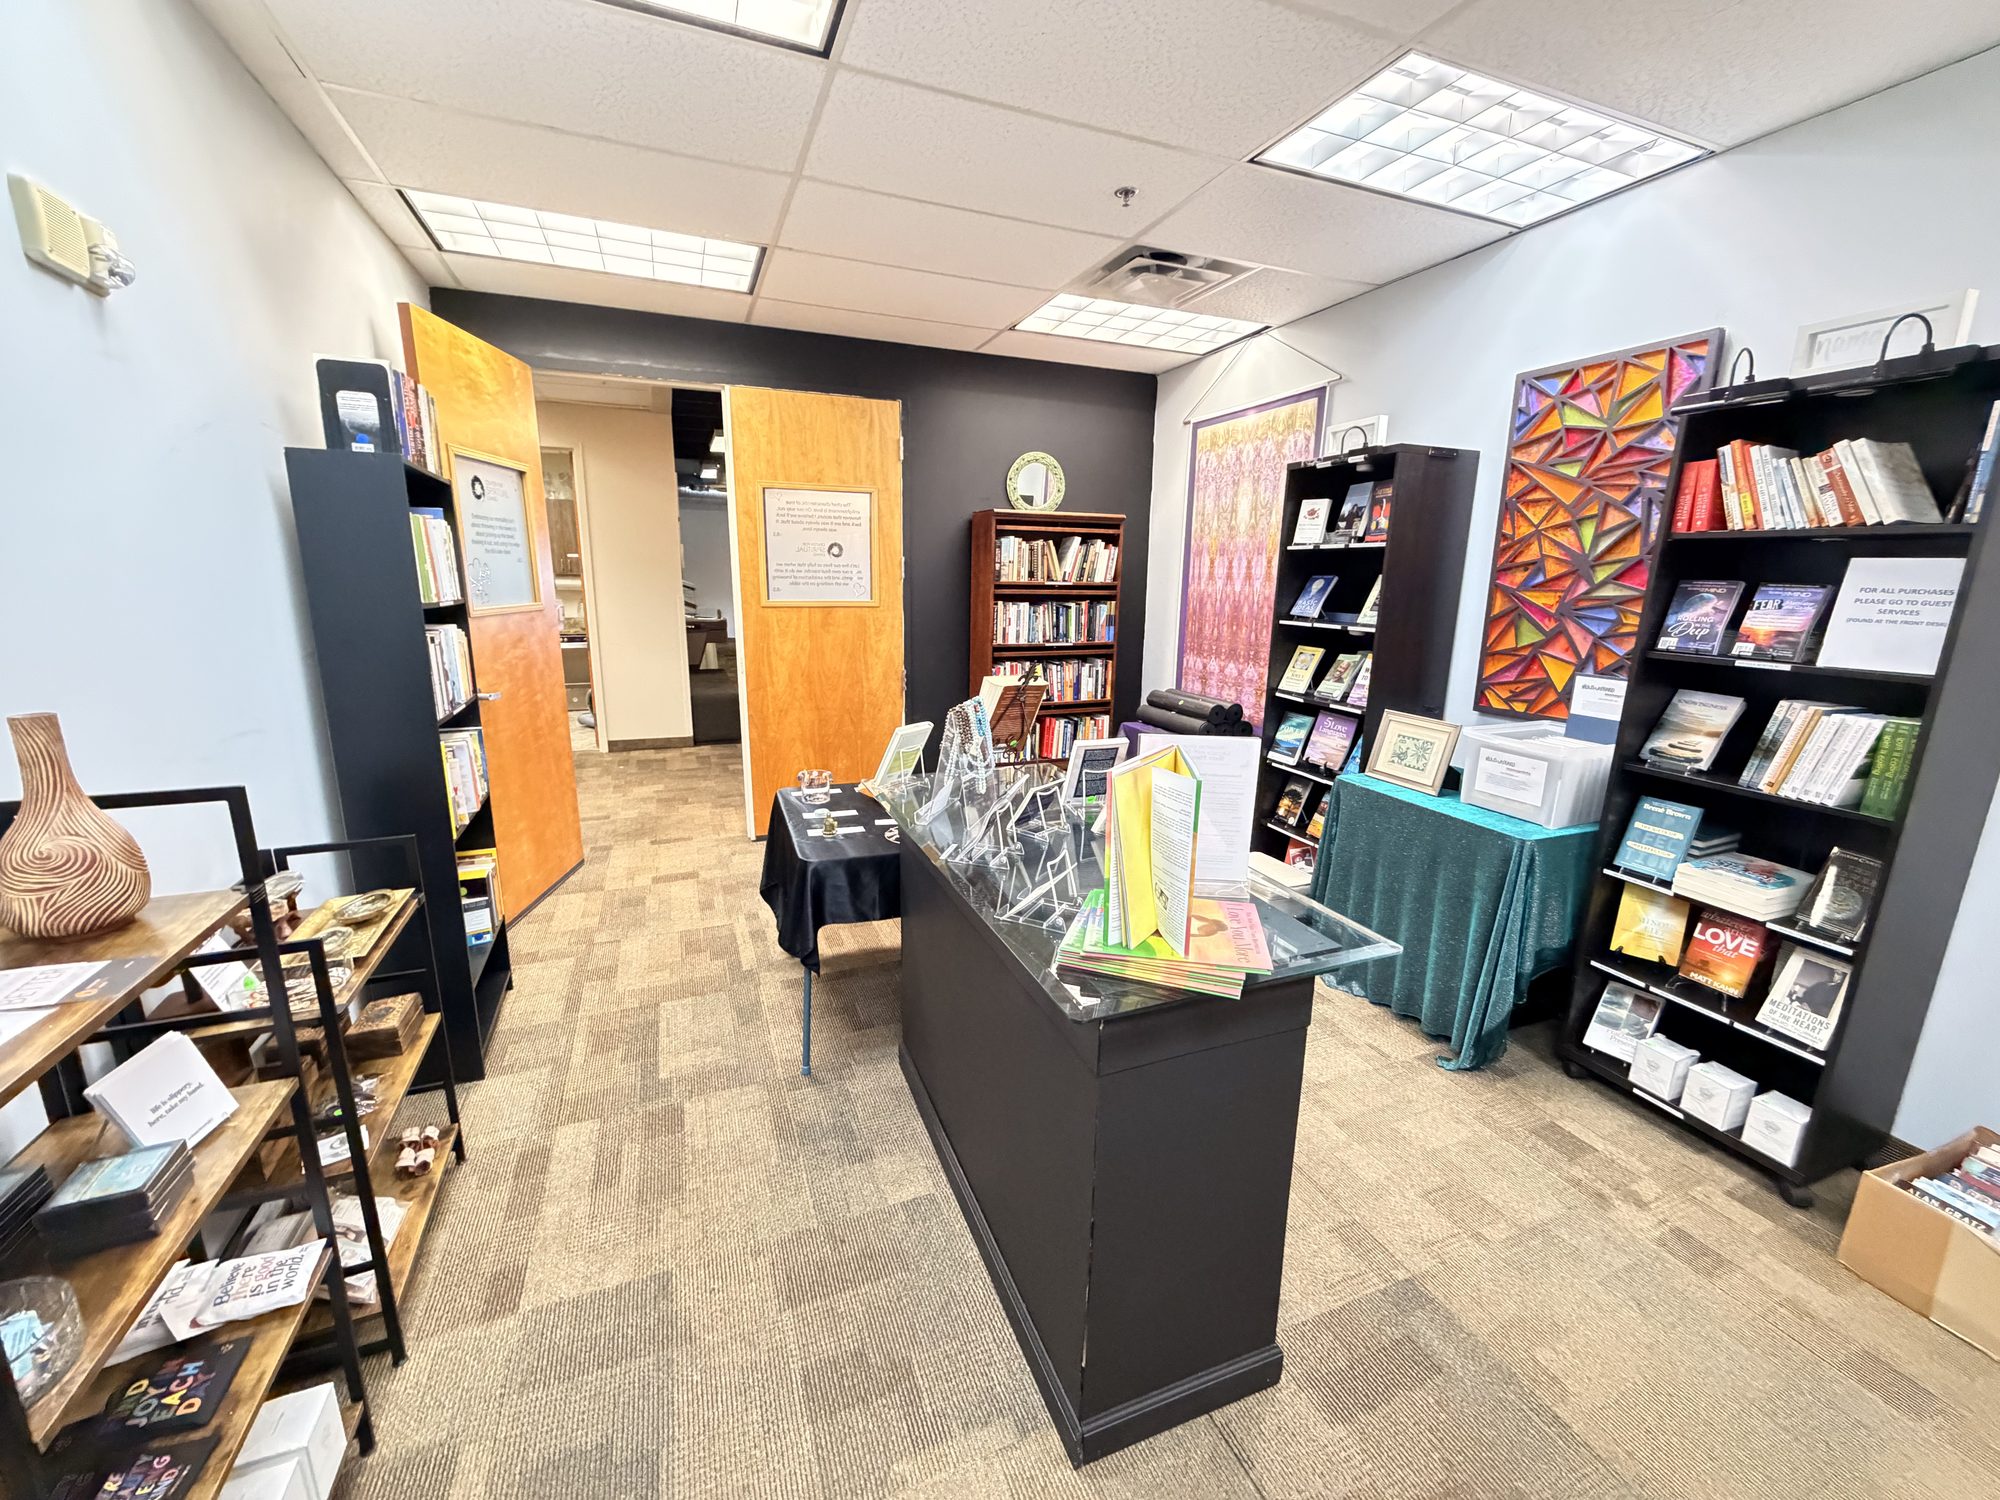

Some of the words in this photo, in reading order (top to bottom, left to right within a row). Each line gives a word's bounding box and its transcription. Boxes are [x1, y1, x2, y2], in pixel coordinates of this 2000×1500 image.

[1753, 600, 1781, 609] FEAR
[1668, 622, 1710, 640] Deep
[1331, 722, 1347, 732] Love
[1643, 803, 1665, 813] Brené
[1667, 809, 1692, 820] Brown
[1693, 922, 1759, 958] LOVE
[1712, 943, 1739, 959] that
[1689, 971, 1713, 986] MATT
[1713, 980, 1740, 996] KAHN
[1768, 999, 1831, 1030] MEDITATIONS
[1778, 1012, 1791, 1023] THE
[1792, 1016, 1823, 1036] HEART
[148, 1114, 166, 1127] here,
[165, 1102, 178, 1114] take
[1907, 1188, 1940, 1208] ALAN
[1944, 1207, 1987, 1231] GRATZ
[255, 1256, 276, 1282] good
[271, 1259, 289, 1280] the
[213, 1262, 246, 1308] Believe
[232, 1265, 256, 1299] there
[249, 1284, 265, 1298] is
[265, 1279, 281, 1294] in
[151, 1360, 205, 1422] EACH
[175, 1370, 216, 1416] DAY
